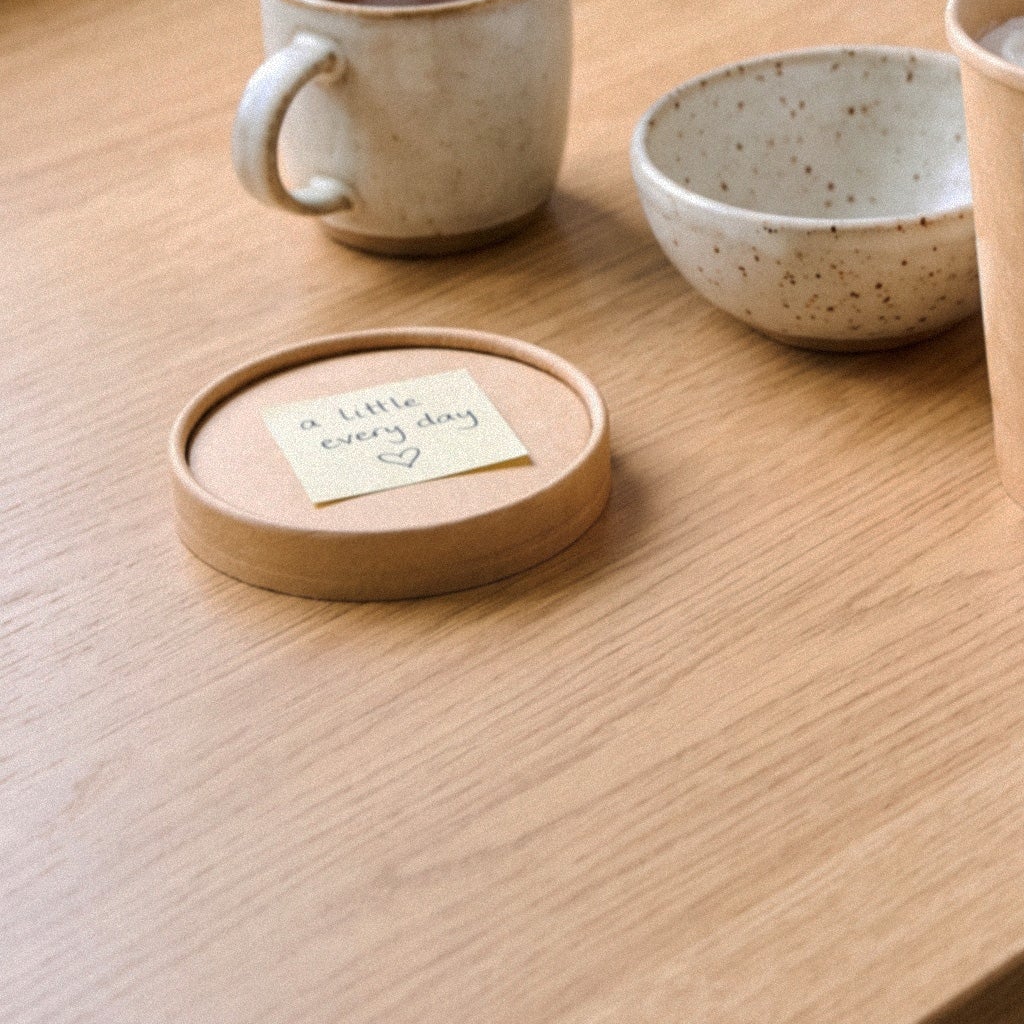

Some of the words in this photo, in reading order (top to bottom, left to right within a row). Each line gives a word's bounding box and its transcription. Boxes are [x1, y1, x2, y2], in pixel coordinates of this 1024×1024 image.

[300, 418, 321, 430] a
[338, 396, 419, 422] little
[321, 425, 407, 450] every
[417, 408, 479, 429] day
